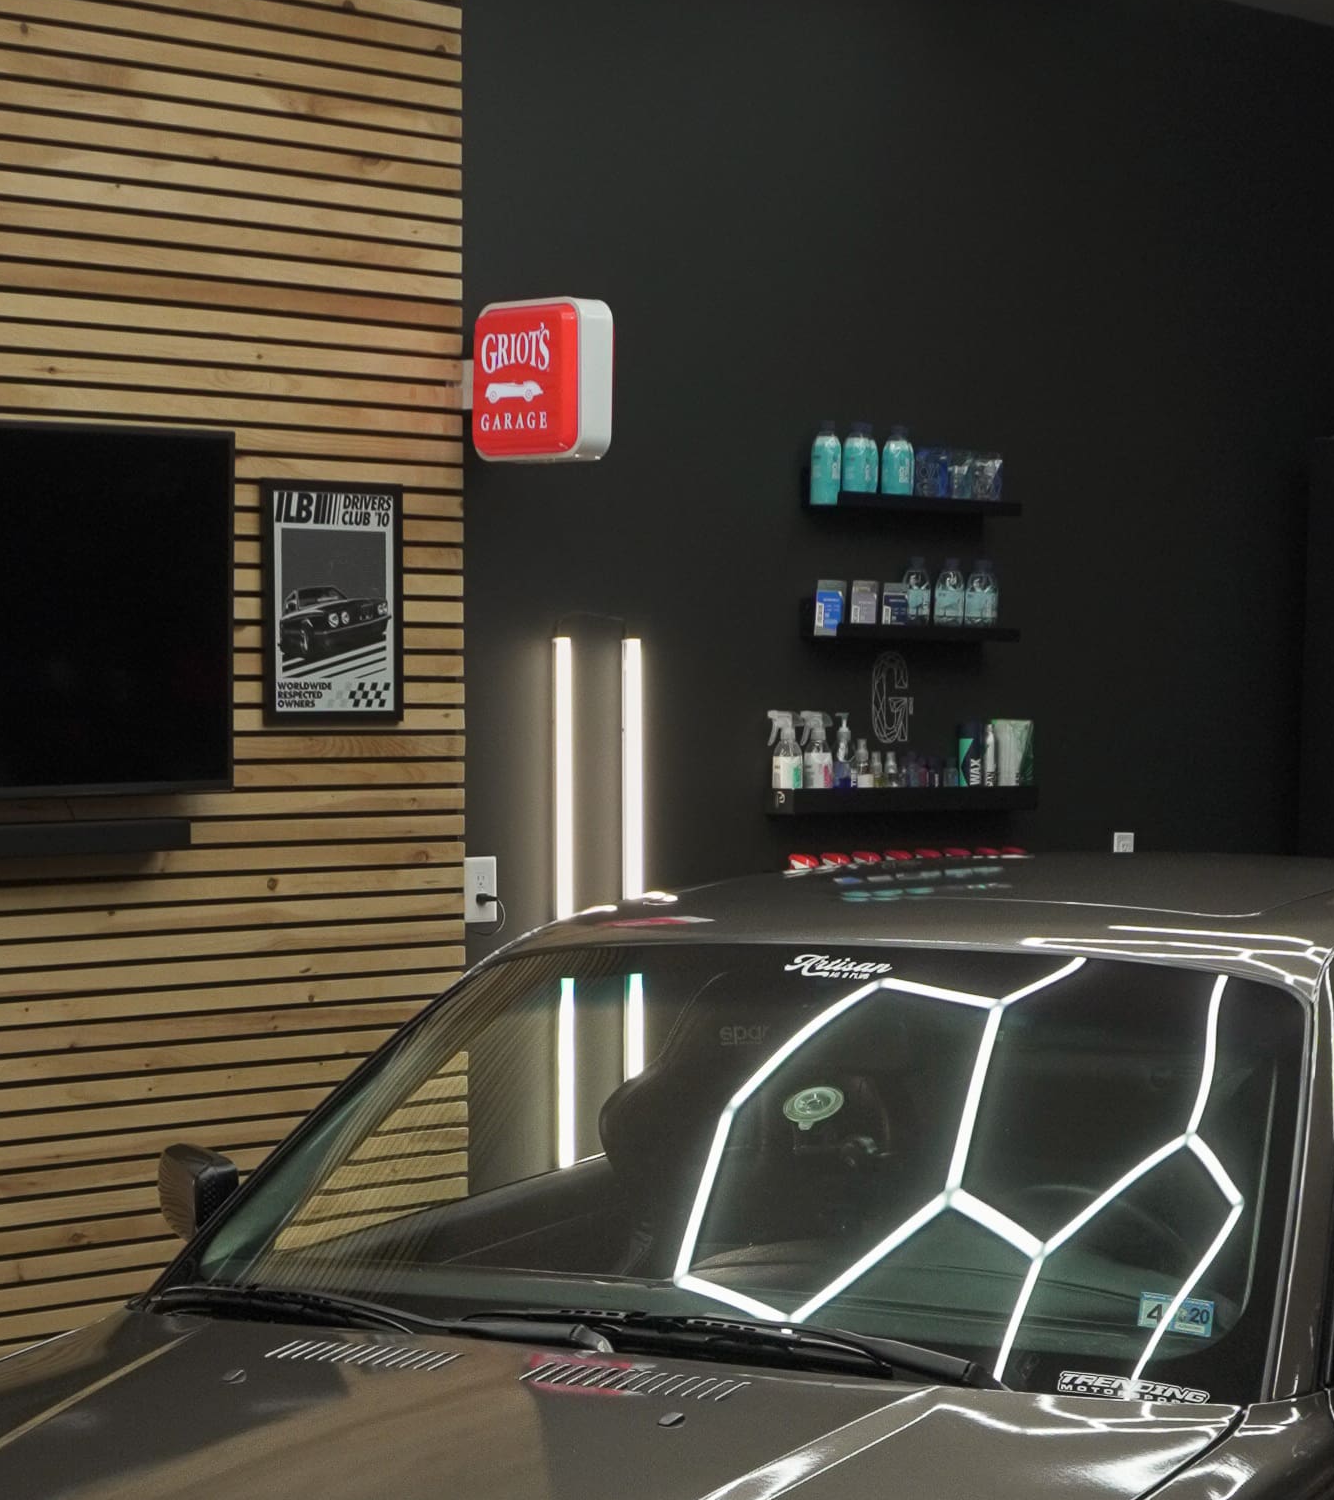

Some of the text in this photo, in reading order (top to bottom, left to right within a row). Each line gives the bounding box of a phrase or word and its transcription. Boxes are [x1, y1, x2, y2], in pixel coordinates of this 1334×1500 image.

[481, 322, 550, 374] GRIOT'S
[480, 411, 548, 431] GARAGE
[343, 495, 392, 511] DRIVERS
[342, 511, 371, 526] CLUB
[277, 682, 332, 691] WORLDWIDE
[277, 690, 323, 700] RESPECTED
[277, 700, 315, 708] OWNERS
[969, 758, 982, 786] WAX
[784, 954, 893, 977] Artisan
[1146, 1303, 1211, 1325] 4 20
